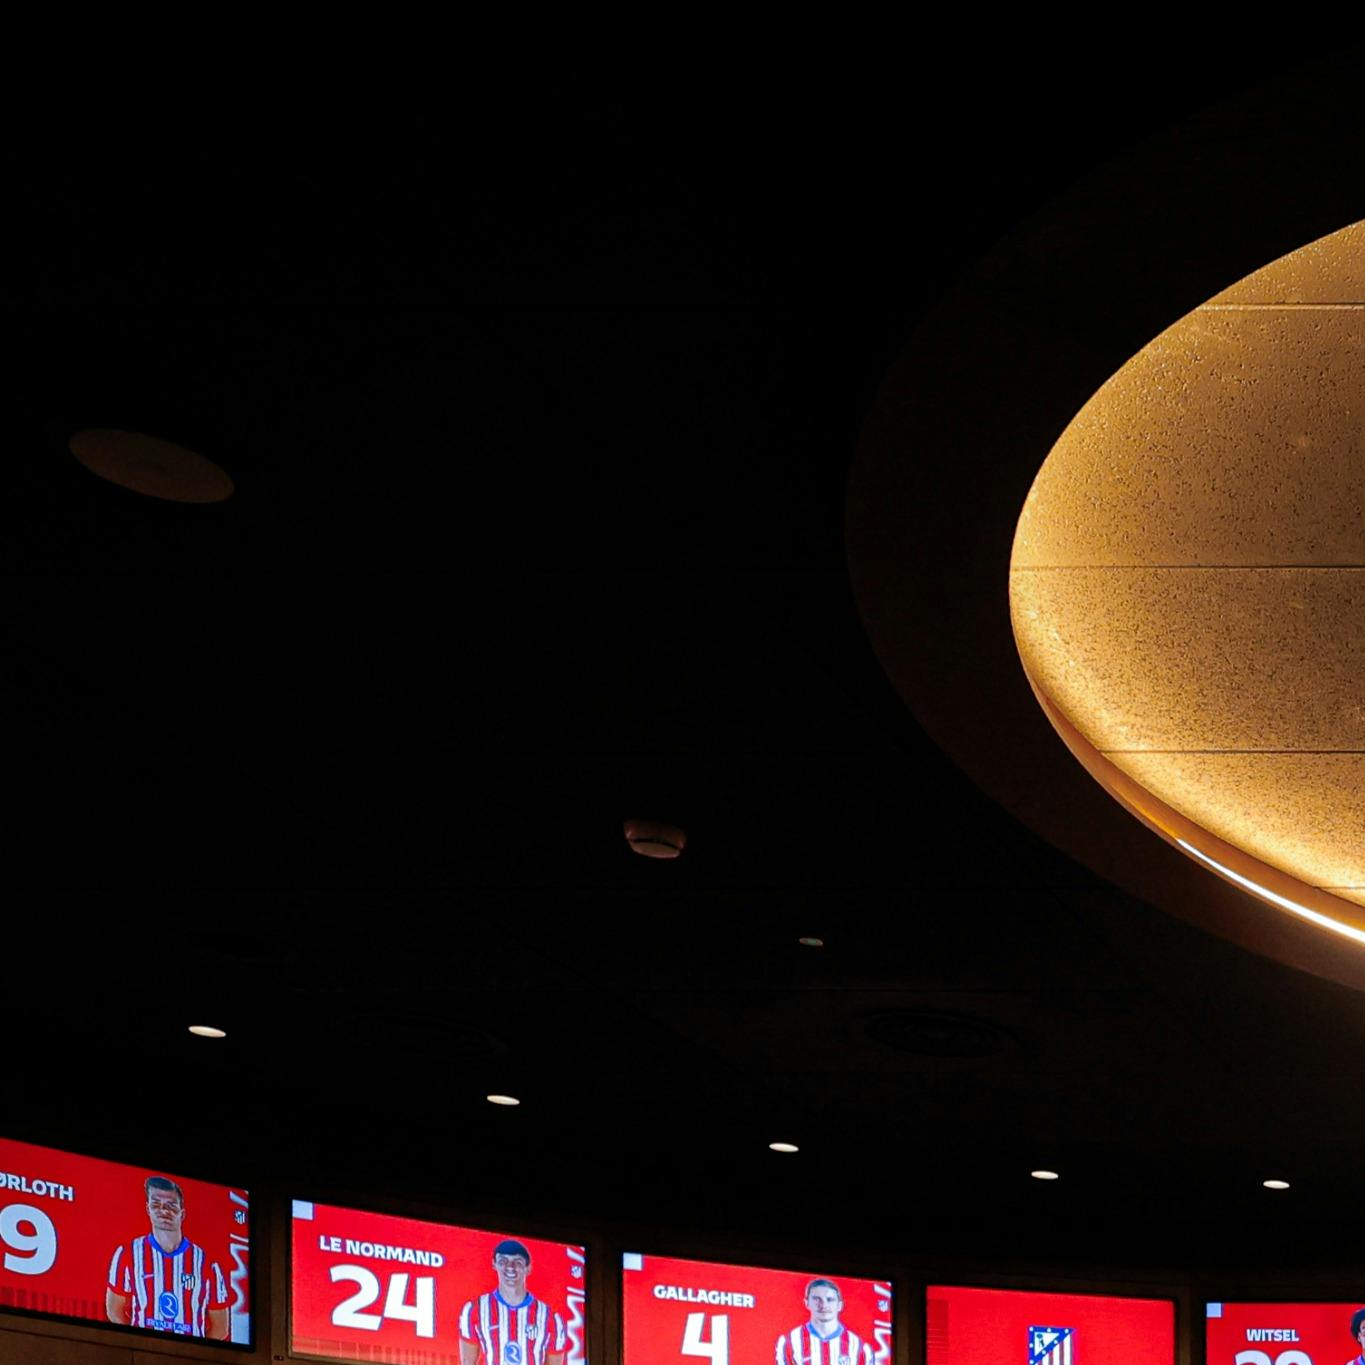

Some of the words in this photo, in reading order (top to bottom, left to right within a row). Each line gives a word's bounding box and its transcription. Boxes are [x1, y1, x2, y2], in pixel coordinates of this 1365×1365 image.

[0, 1204, 57, 1275] 9
[319, 1235, 342, 1253] LE
[344, 1239, 445, 1268] NORMAND
[328, 1264, 445, 1339] 24
[653, 1284, 755, 1309] GALLAGHER
[1246, 1328, 1300, 1342] WITSEL
